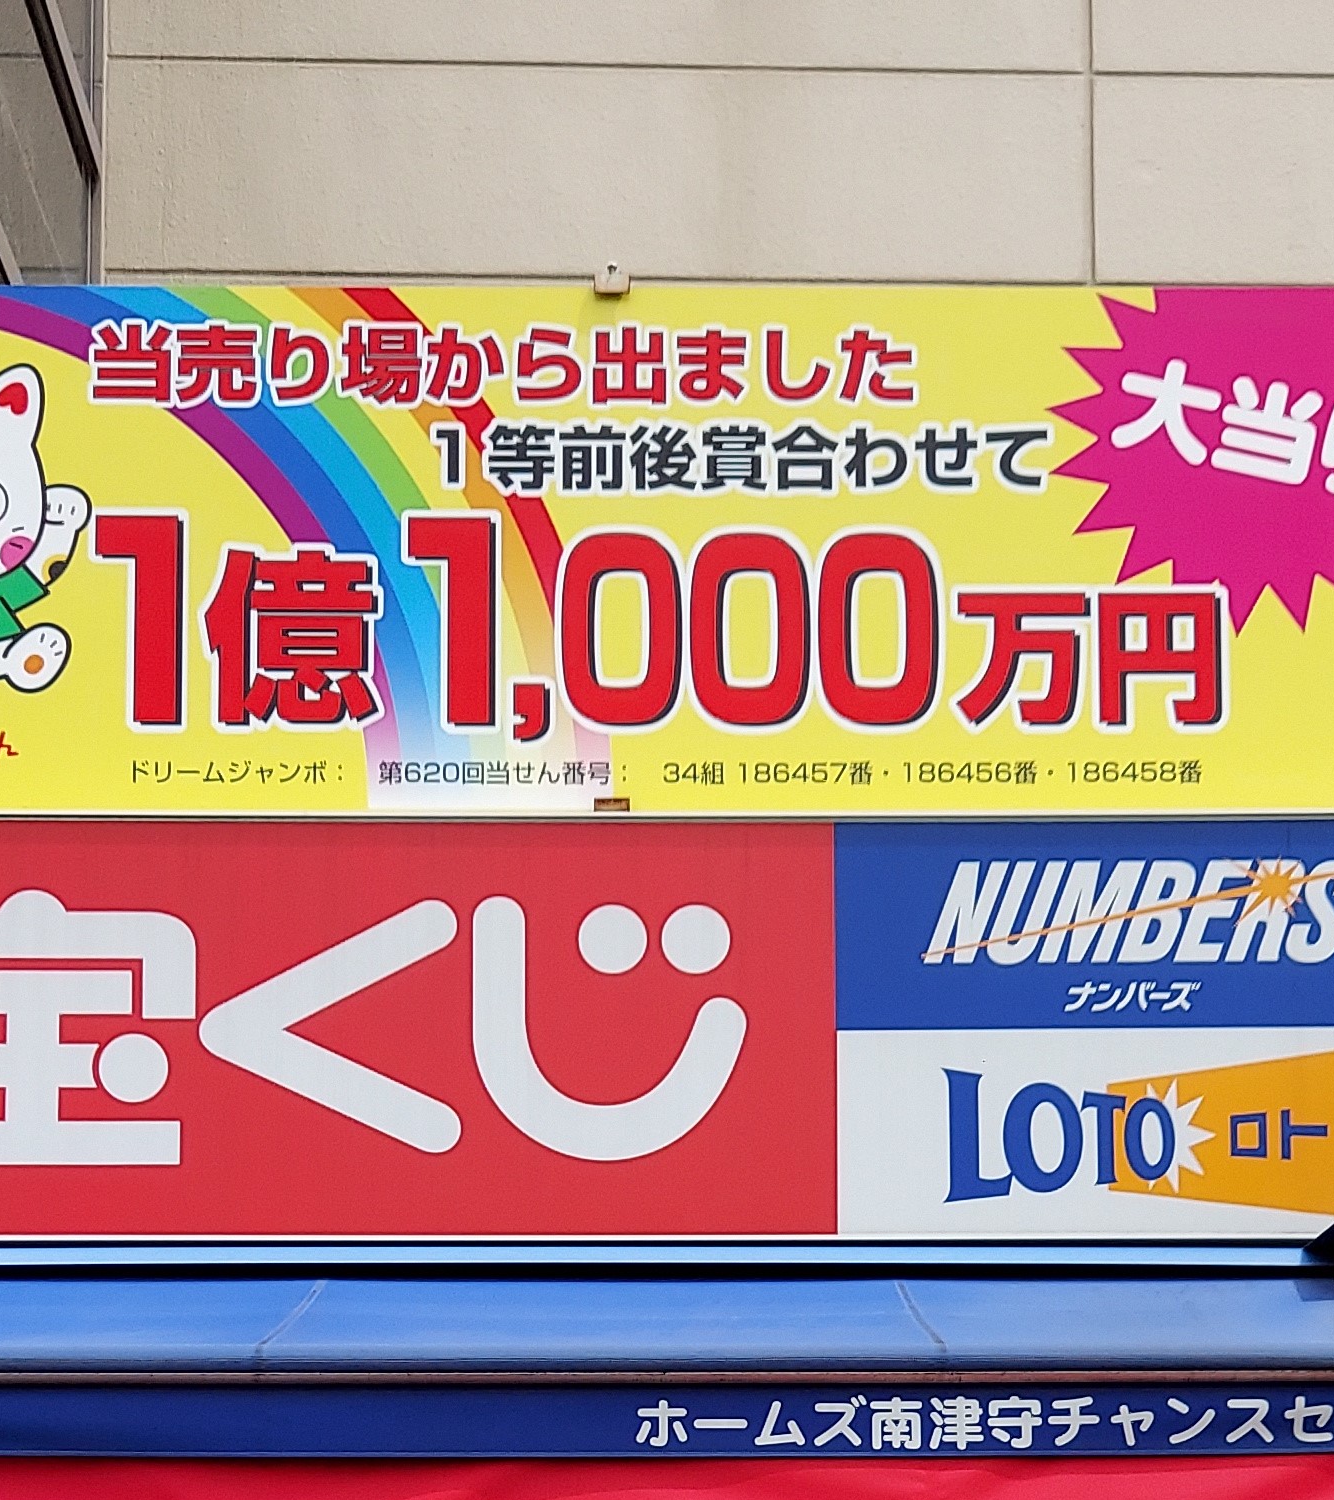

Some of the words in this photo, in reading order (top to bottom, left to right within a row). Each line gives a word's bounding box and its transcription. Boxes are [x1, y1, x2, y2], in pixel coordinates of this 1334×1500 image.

[89, 324, 914, 406] 当売り場から出ました
[435, 426, 1049, 490] 1等前後賞合わせて
[95, 515, 1223, 740] 1億1,000万円
[1063, 981, 1202, 1013] ナンバーズ
[942, 1067, 1176, 1204] LOTO
[1229, 1109, 1328, 1161] ロト
